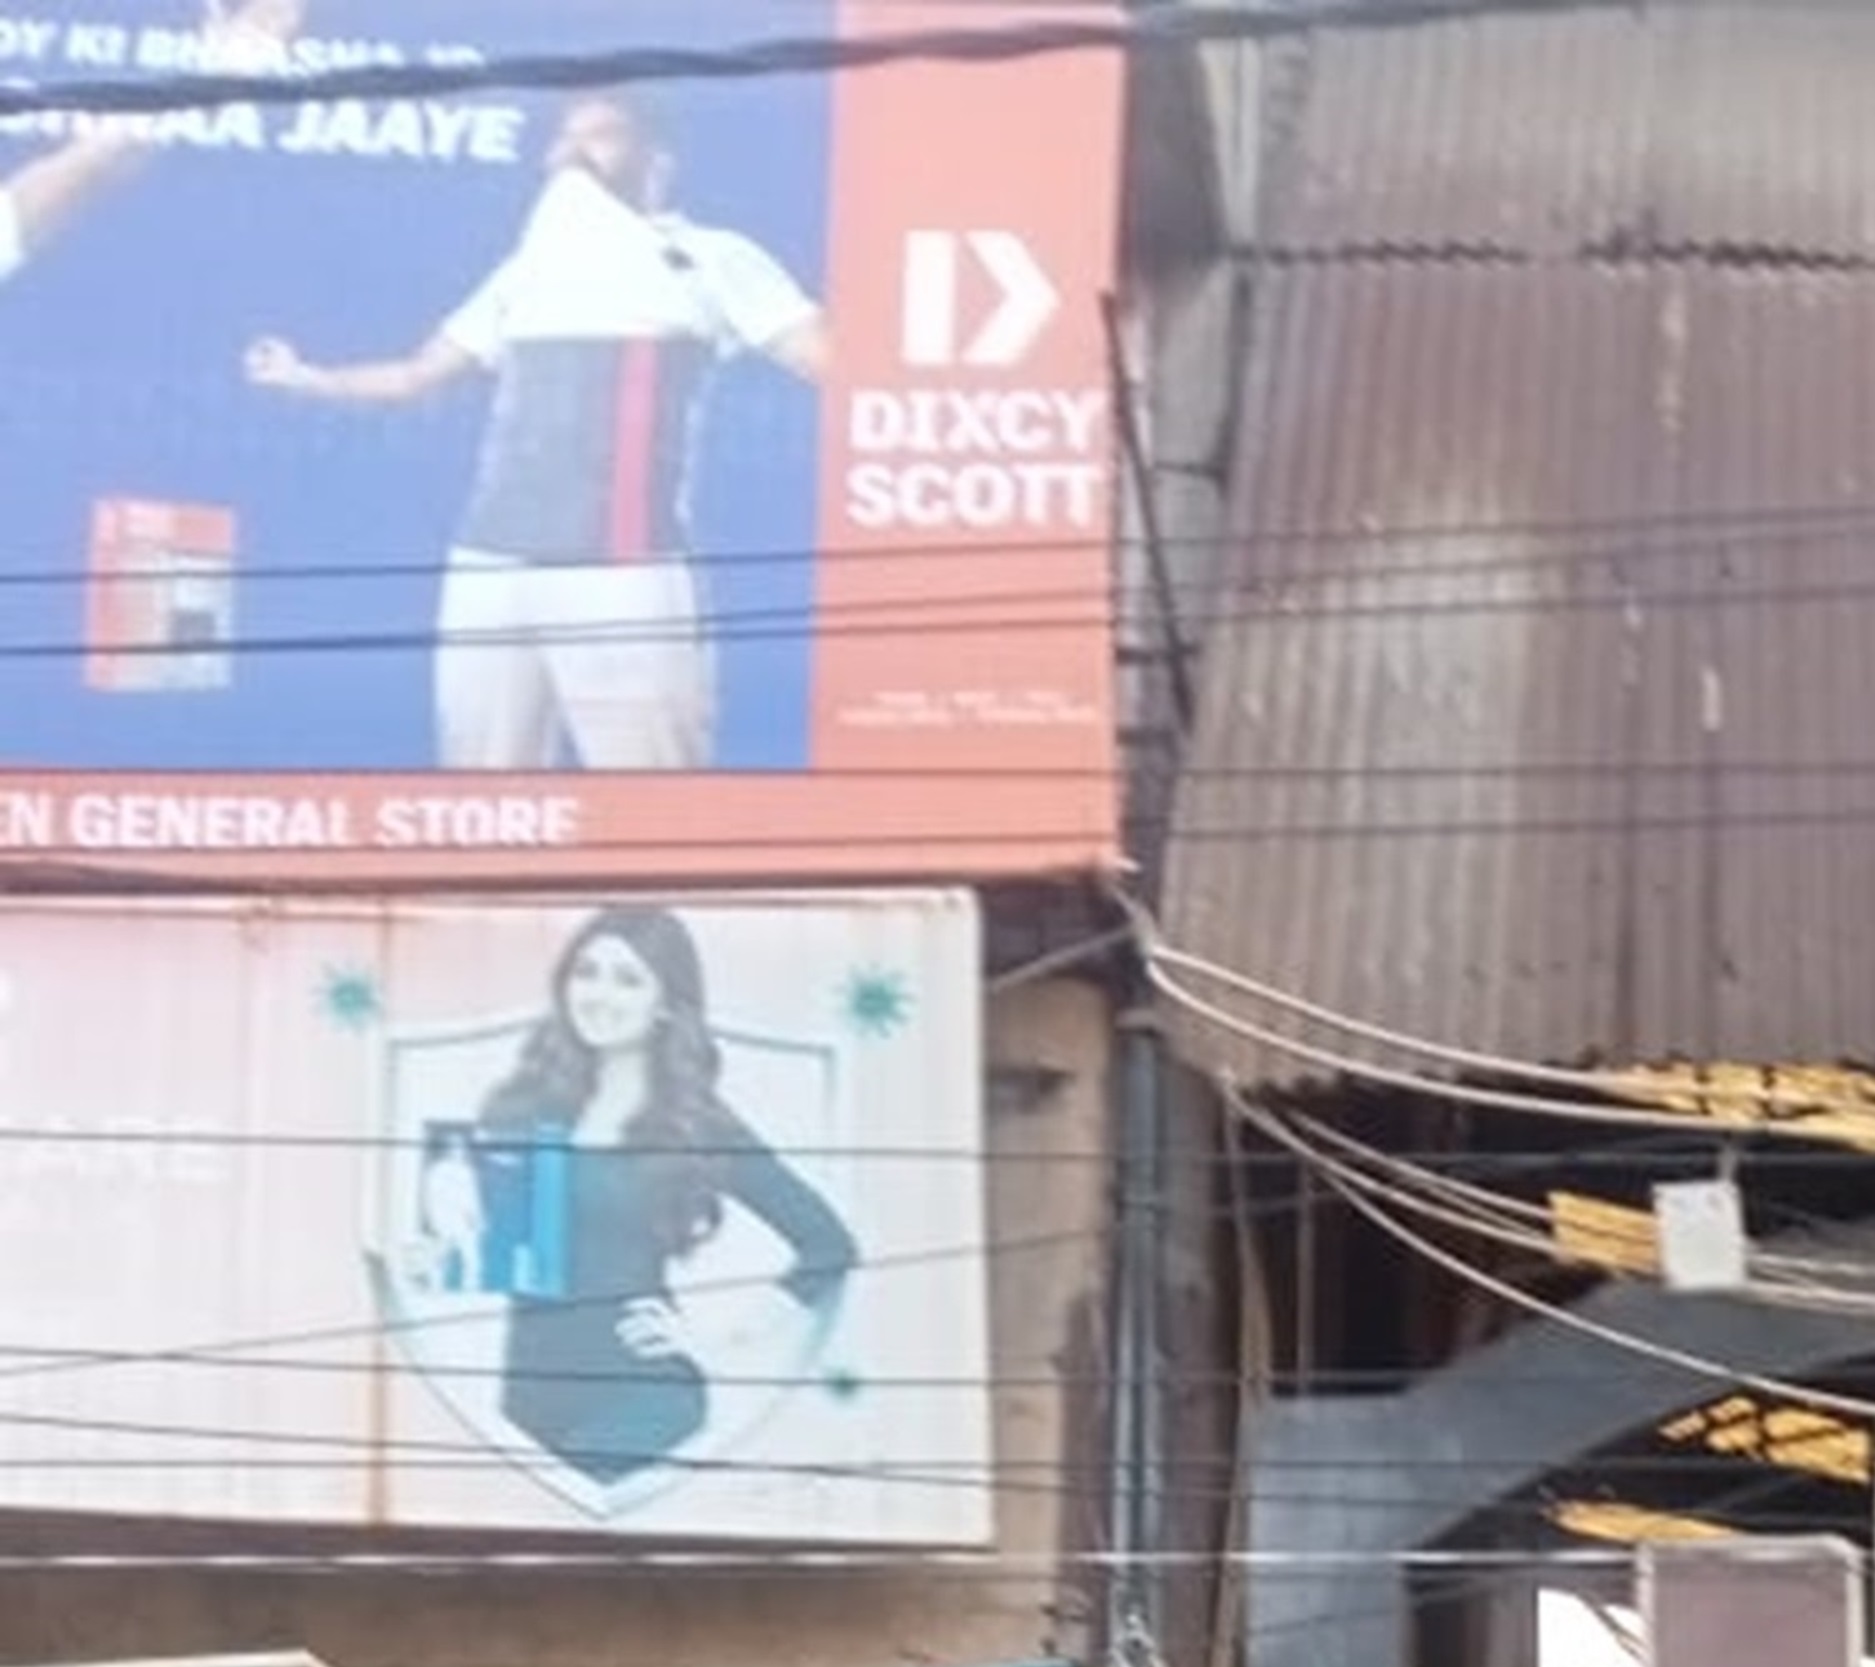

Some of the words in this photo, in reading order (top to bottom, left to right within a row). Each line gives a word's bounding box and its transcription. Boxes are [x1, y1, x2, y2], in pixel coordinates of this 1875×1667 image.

[277, 98, 526, 164] JAAYE
[849, 391, 1102, 453] DIXCY
[846, 463, 1101, 528] SCOTT
[68, 792, 353, 847] GENERAL
[373, 796, 581, 846] STORE
